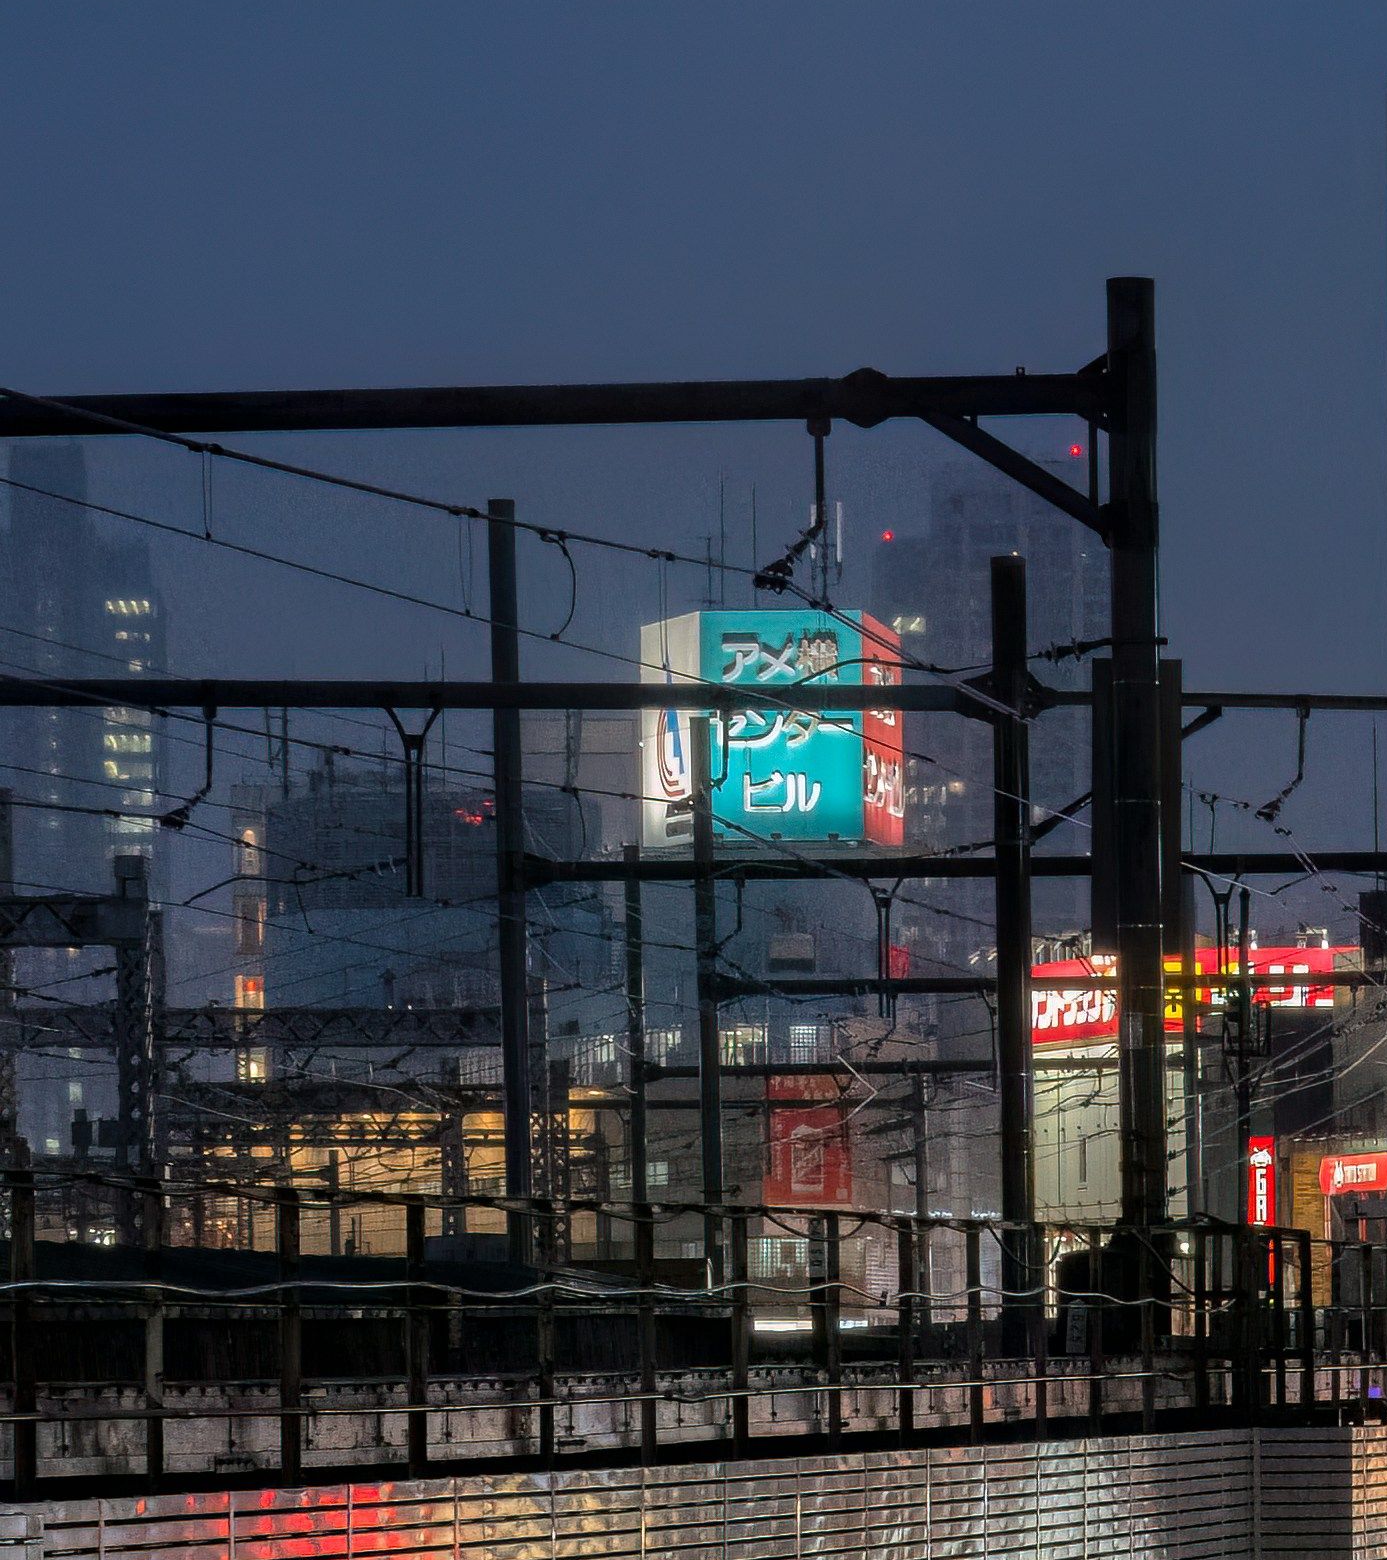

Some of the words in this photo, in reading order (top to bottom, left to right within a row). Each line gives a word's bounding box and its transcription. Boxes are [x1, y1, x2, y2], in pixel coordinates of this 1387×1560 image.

[721, 628, 839, 681] アメ横
[743, 771, 821, 813] ビル
